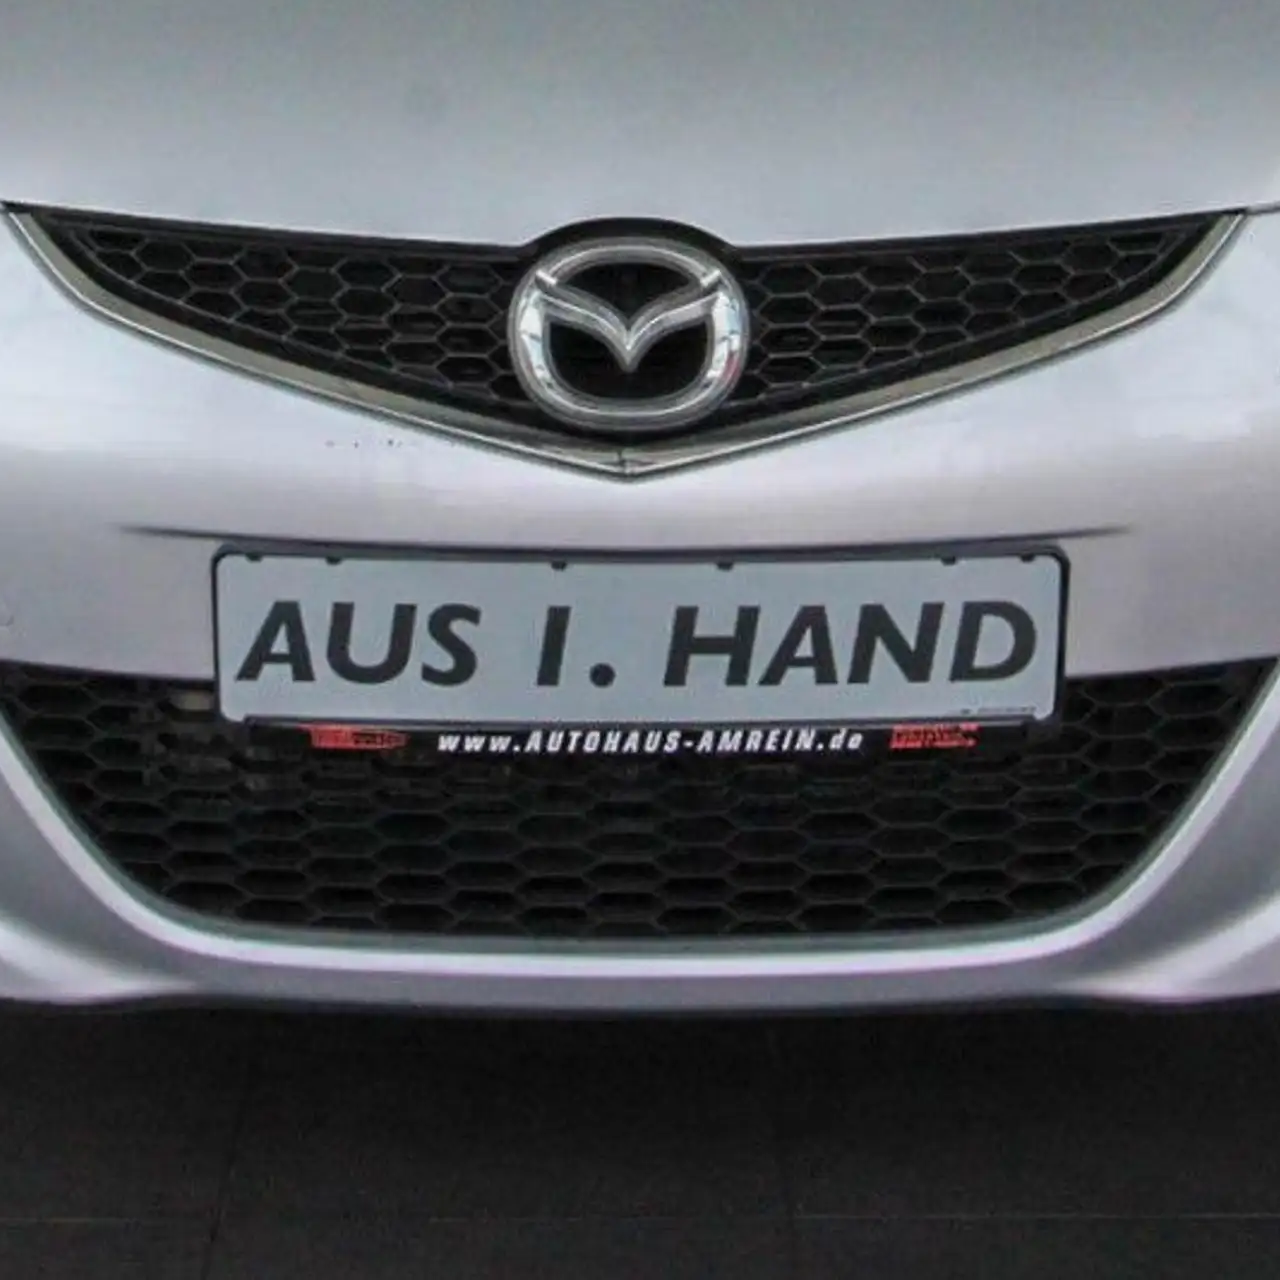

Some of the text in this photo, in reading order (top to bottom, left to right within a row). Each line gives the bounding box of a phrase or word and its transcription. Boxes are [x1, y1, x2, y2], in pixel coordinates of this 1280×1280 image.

[236, 601, 482, 687] AUS
[663, 601, 1037, 687] HAND
[438, 727, 863, 754] www.AUTOHAUS-AMREIN.de
